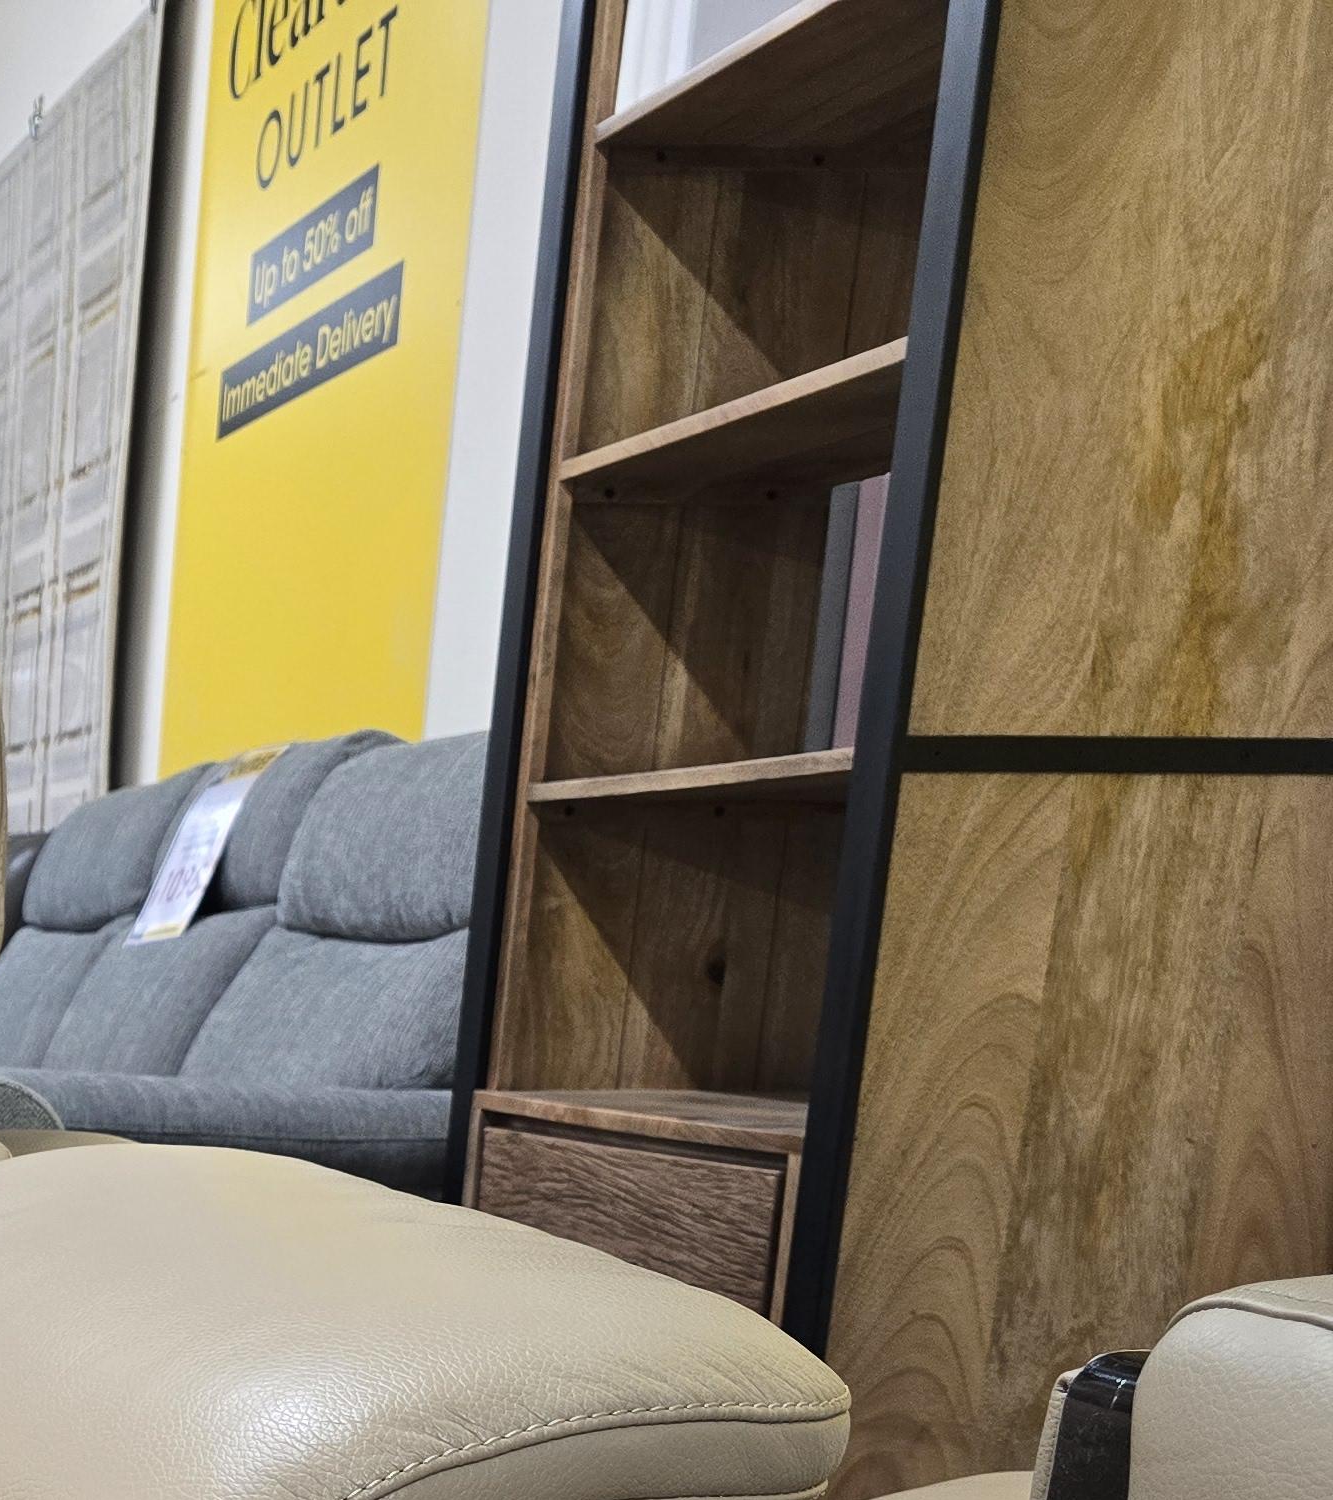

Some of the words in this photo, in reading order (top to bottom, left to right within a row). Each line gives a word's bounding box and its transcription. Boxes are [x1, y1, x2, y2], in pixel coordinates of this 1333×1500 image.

[257, 6, 397, 188] OUTLET
[254, 261, 278, 308] Up
[282, 245, 299, 285] to
[303, 211, 341, 271] 50%
[346, 187, 374, 243] off
[222, 341, 312, 421] Immediate
[316, 295, 398, 369] Delivery
